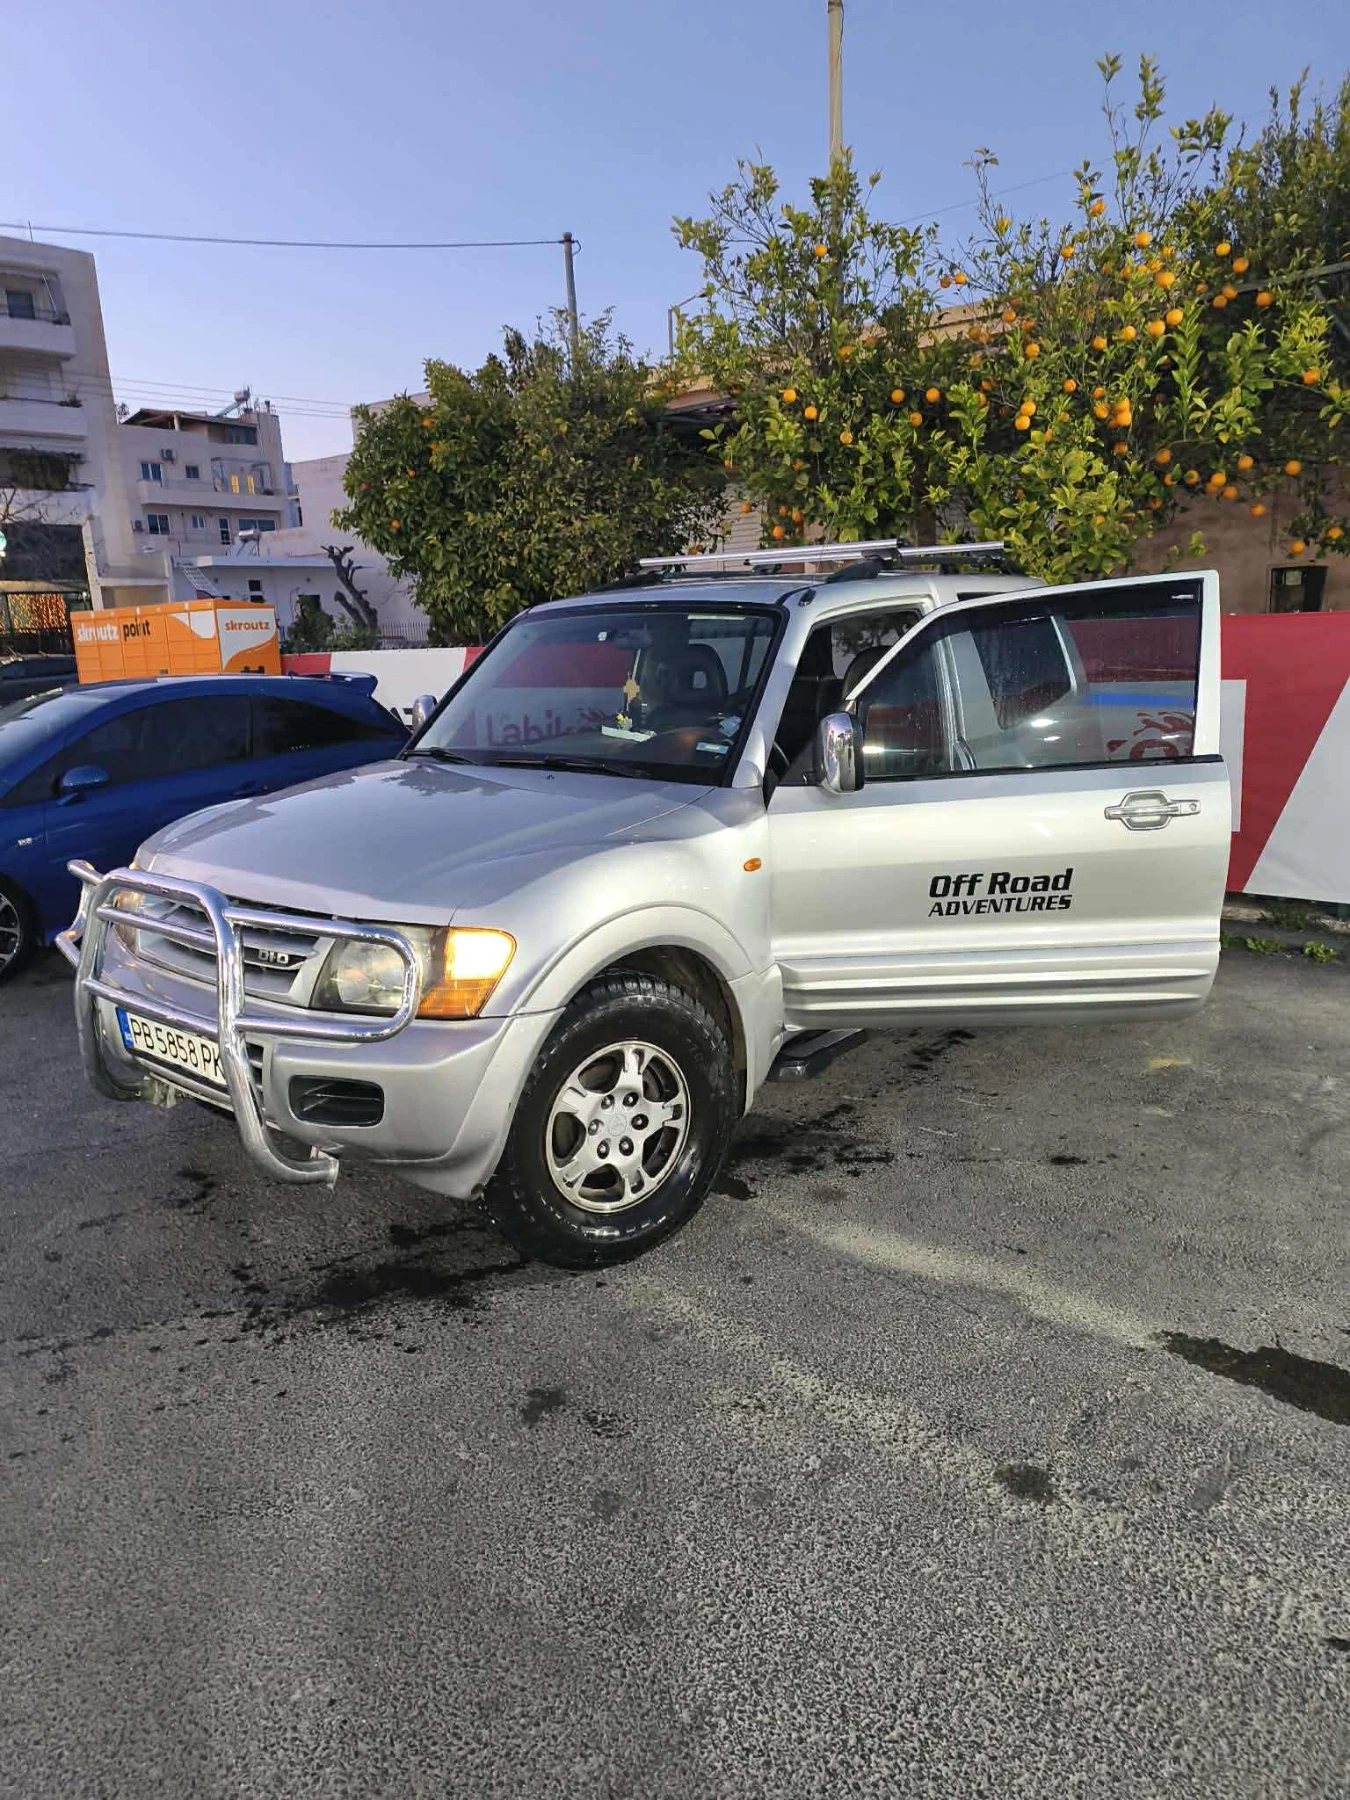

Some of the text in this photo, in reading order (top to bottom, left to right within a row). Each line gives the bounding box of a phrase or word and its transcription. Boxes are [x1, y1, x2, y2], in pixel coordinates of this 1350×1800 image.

[124, 618, 151, 641] point
[225, 619, 270, 632] skroutz
[929, 868, 1074, 897] Off Road
[928, 894, 1073, 917] ADVENTURES
[130, 1018, 154, 1050] PB
[154, 1027, 199, 1068] 5858
